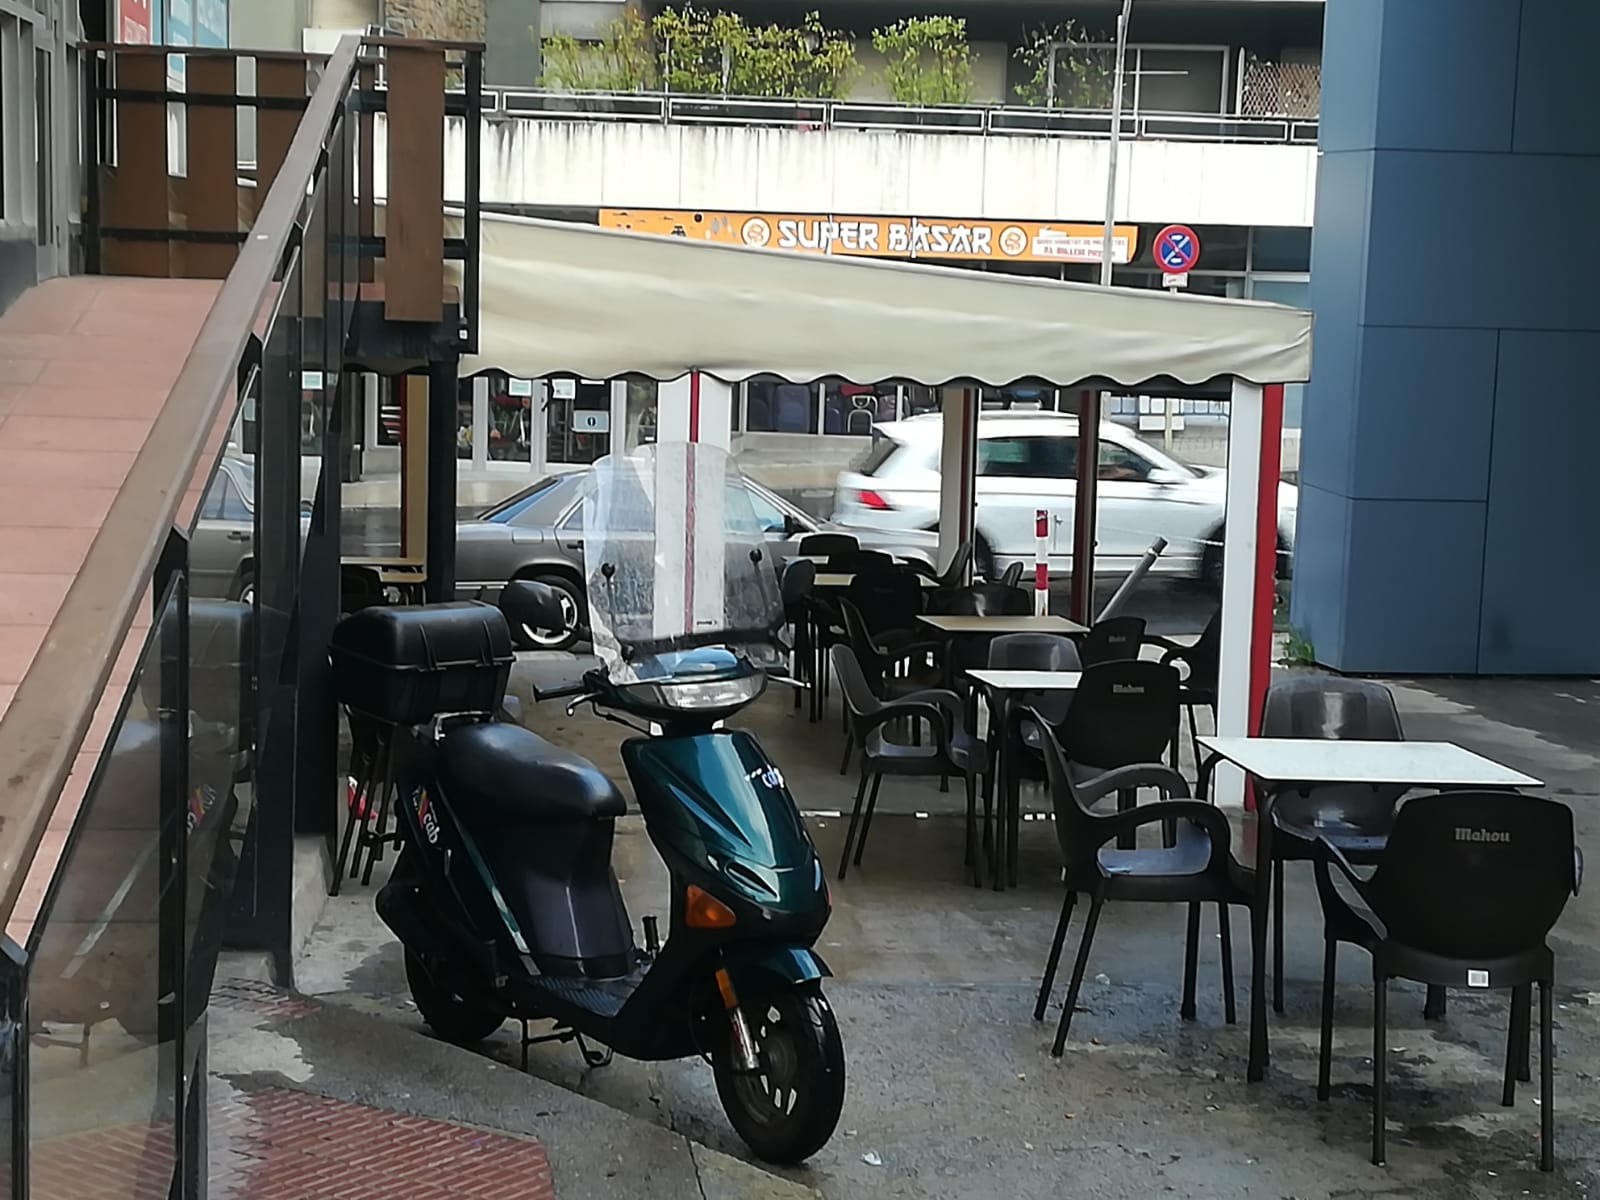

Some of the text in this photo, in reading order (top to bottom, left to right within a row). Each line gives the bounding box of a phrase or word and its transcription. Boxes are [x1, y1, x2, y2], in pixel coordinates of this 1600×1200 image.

[778, 221, 992, 255] SUPER BASAR
[423, 812, 440, 845] cab
[1454, 827, 1511, 843] Mahou
